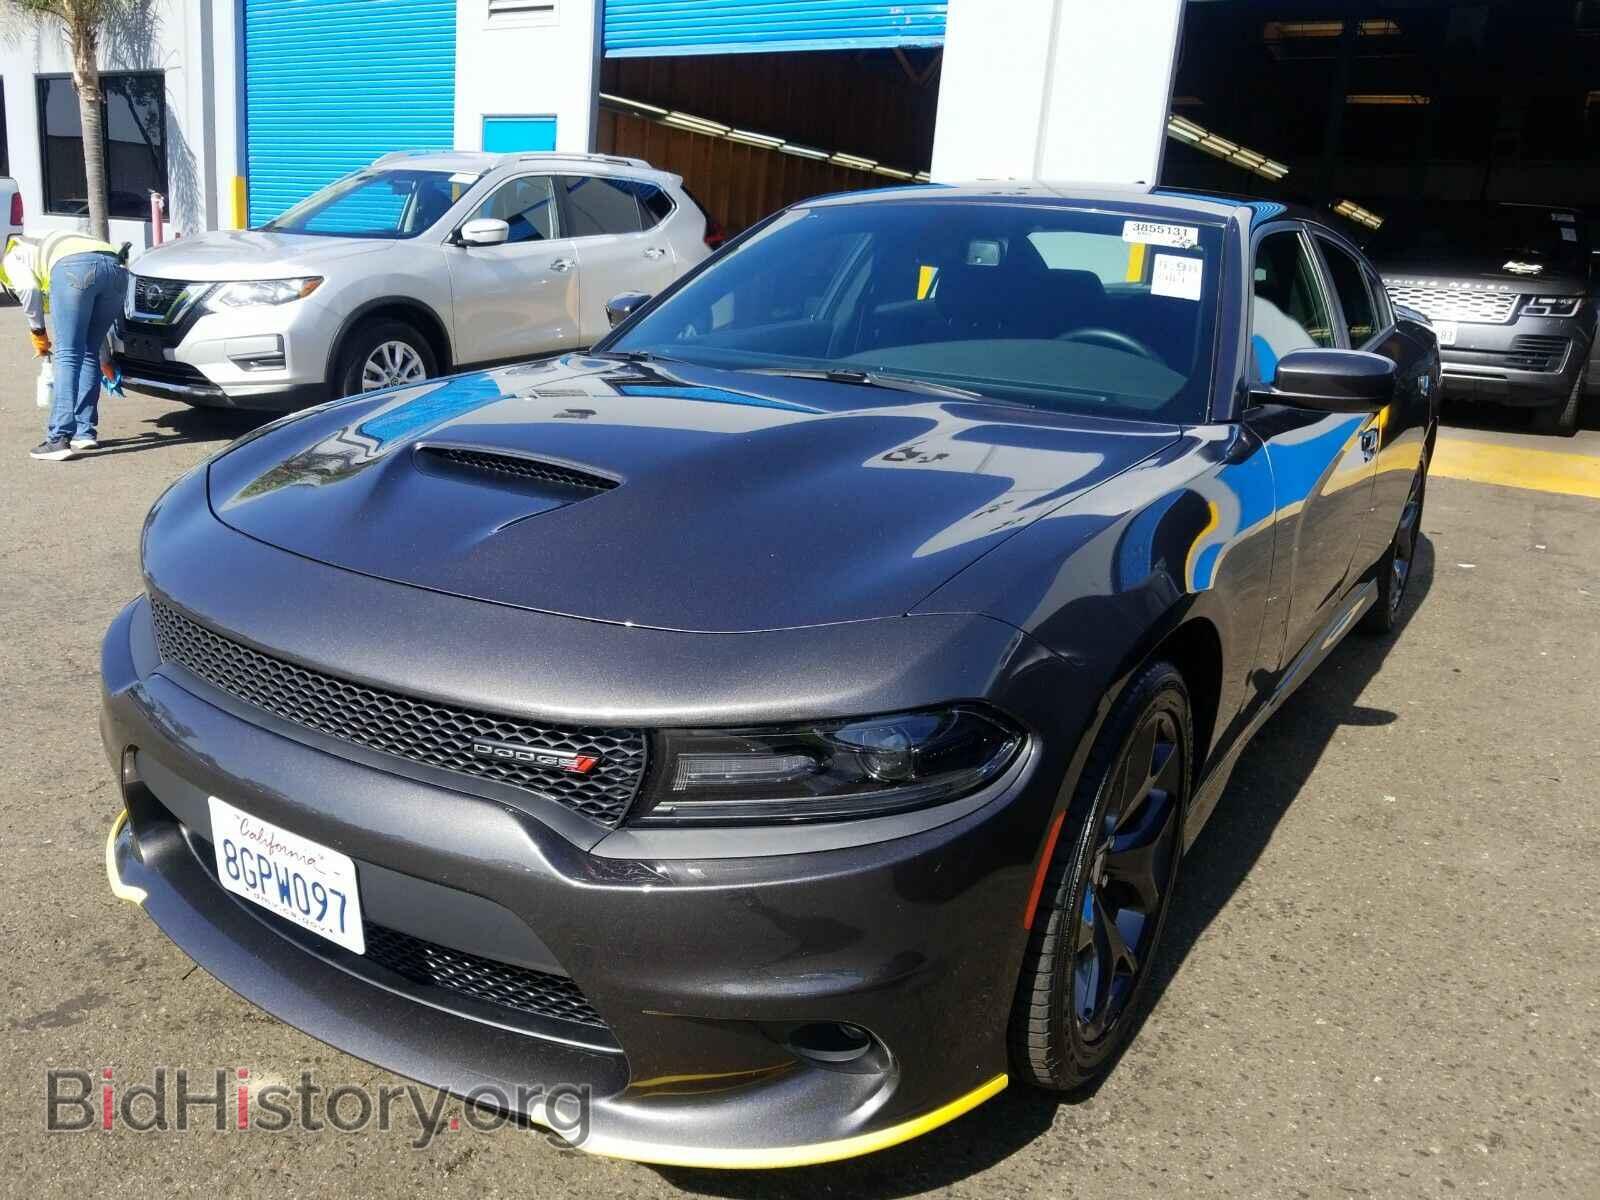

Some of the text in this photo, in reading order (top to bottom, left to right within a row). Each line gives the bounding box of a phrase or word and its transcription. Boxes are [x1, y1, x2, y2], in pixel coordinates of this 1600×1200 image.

[1132, 223, 1188, 237] 3855131
[474, 743, 578, 768] DODGE
[239, 817, 317, 866] California
[223, 838, 347, 933] 8GPW097
